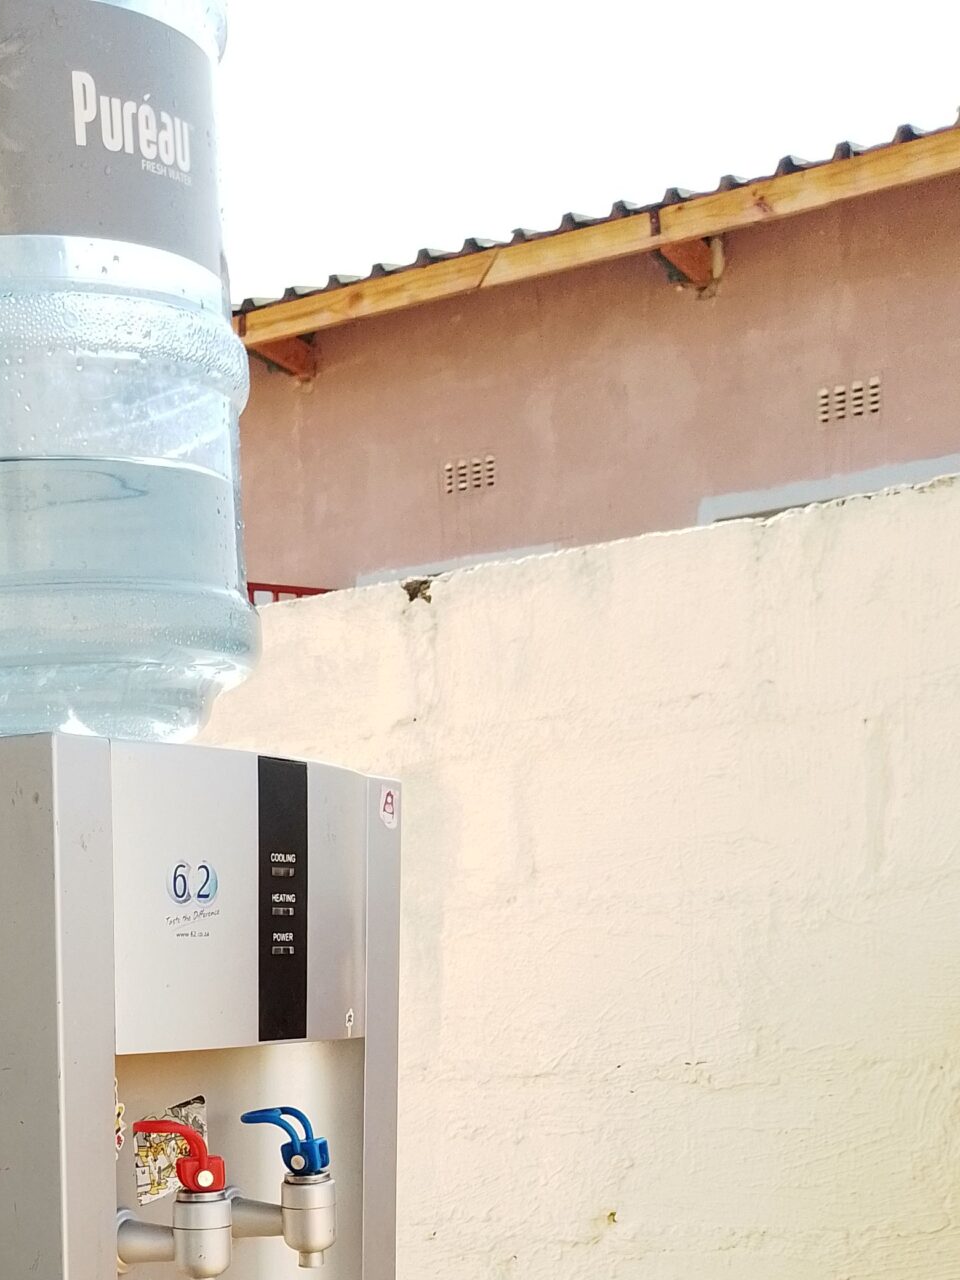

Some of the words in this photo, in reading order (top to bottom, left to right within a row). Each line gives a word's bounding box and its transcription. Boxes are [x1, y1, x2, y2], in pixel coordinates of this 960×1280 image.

[71, 70, 191, 173] Puréau
[141, 159, 167, 176] FRESH
[168, 167, 193, 186] WATER
[270, 853, 296, 863] COOLING
[271, 893, 296, 903] HEATING
[272, 932, 294, 942] POWER
